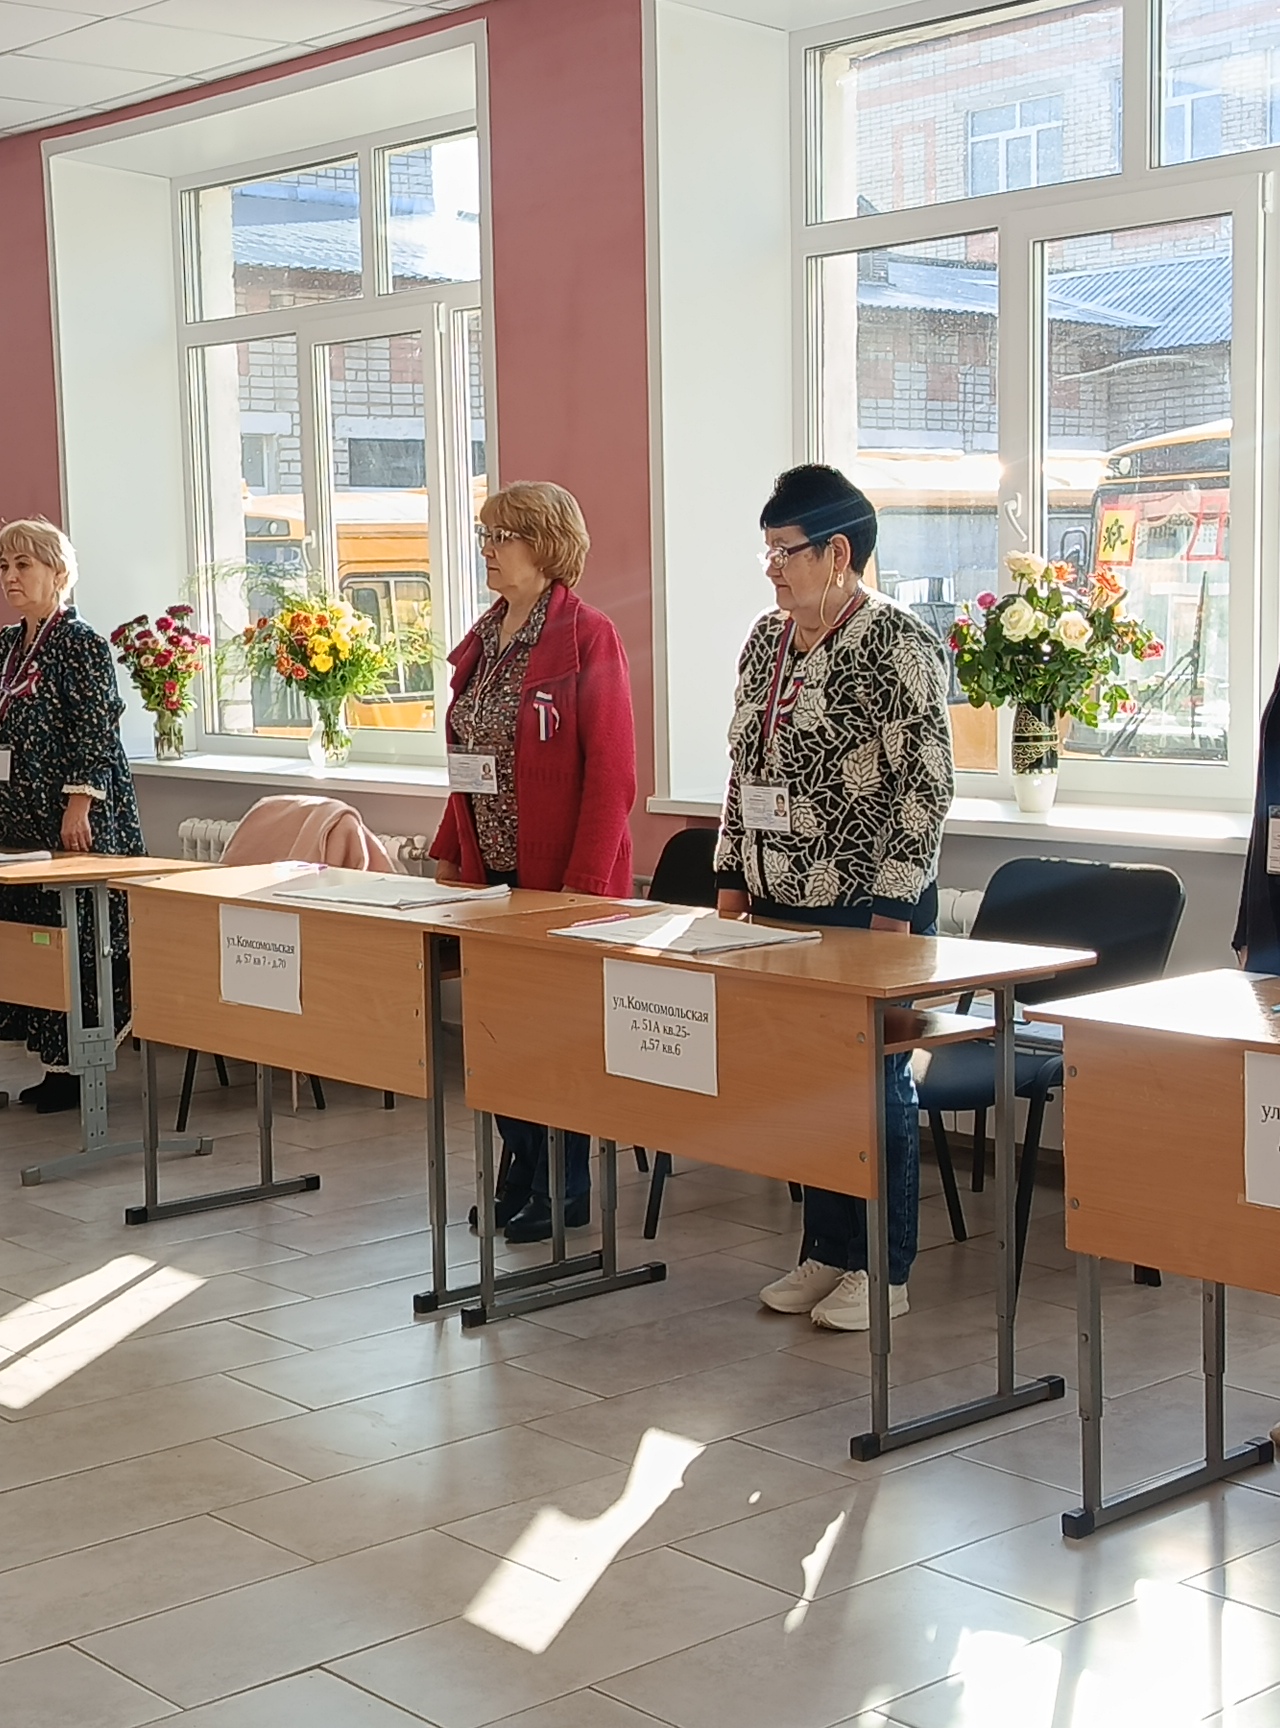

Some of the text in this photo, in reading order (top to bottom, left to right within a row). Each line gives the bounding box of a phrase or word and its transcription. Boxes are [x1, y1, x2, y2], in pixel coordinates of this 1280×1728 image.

[226, 935, 295, 954] ул.Комсомольская
[244, 953, 252, 964] 57
[612, 995, 709, 1023] ул.Комсомольская
[642, 1018, 661, 1034] 51А
[663, 1024, 691, 1039] кв.25-
[640, 1038, 681, 1056] д.57 кв.6
